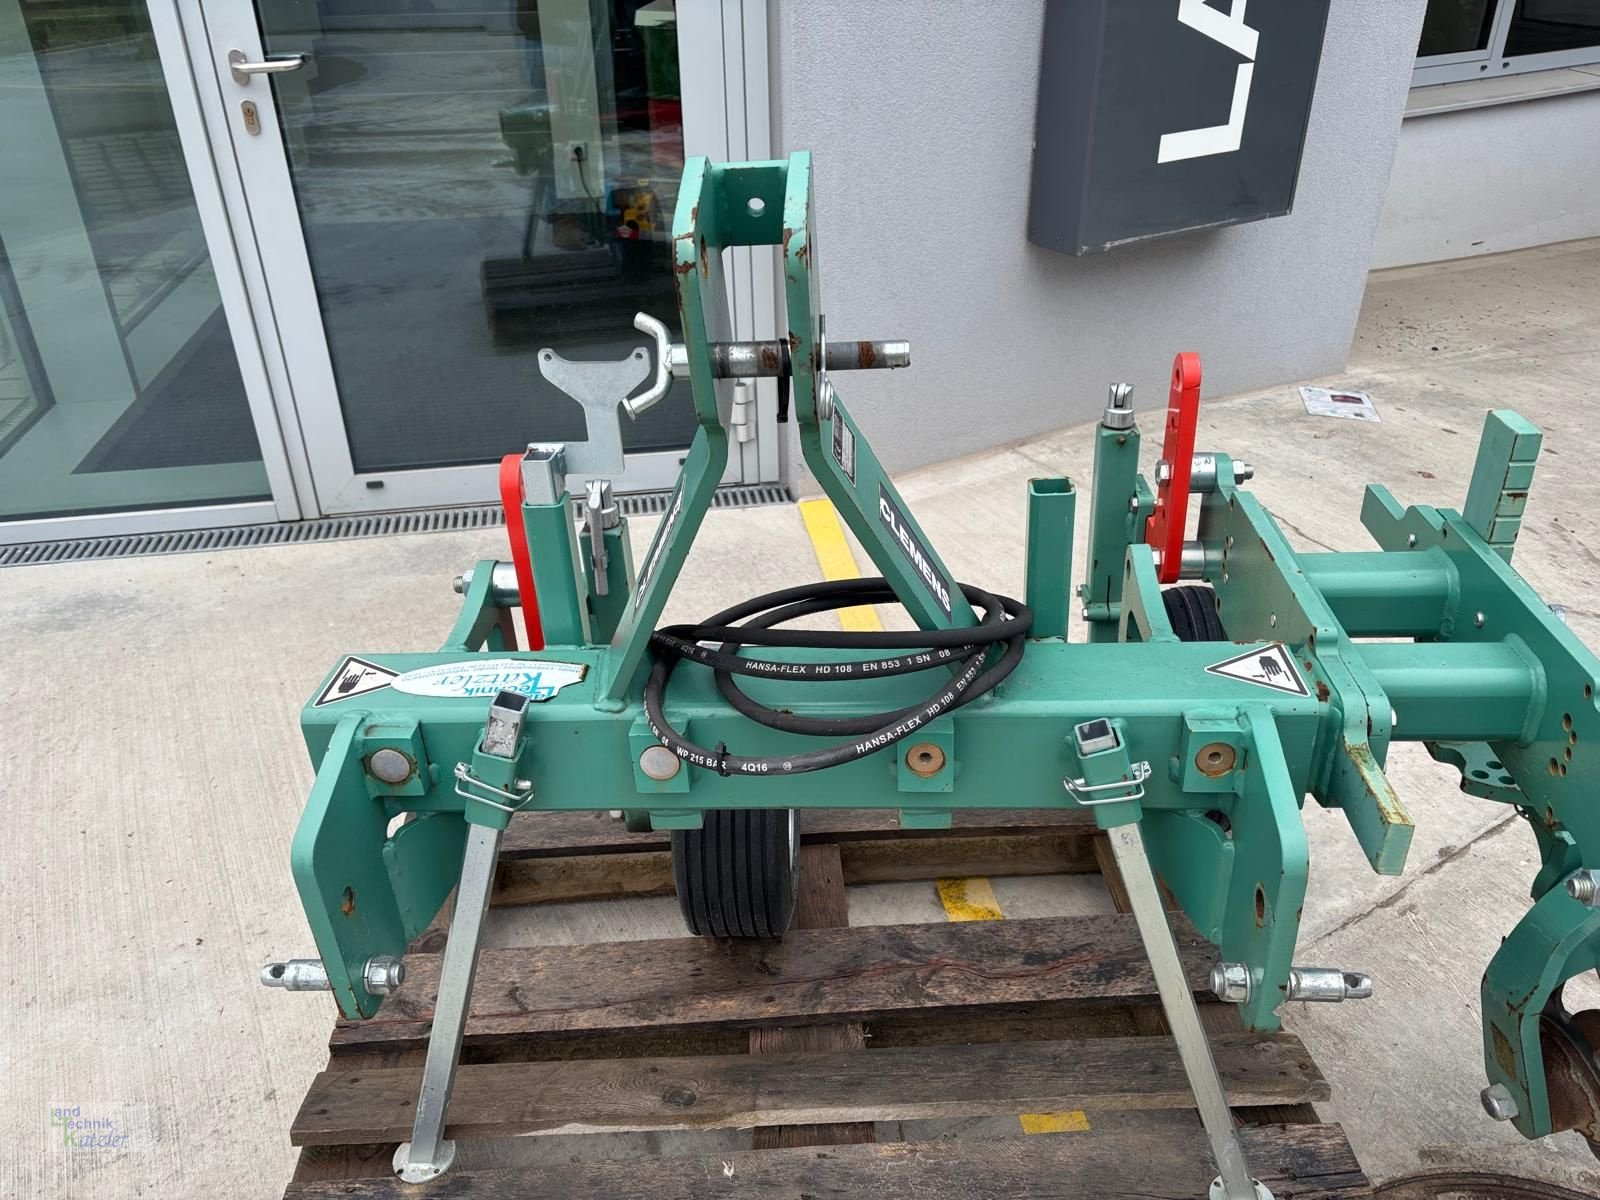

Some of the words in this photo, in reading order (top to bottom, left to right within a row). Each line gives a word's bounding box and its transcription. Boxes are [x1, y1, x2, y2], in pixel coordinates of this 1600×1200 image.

[880, 497, 951, 612] CLEMENS
[745, 661, 806, 674] HANSA-FLEX
[815, 666, 831, 674] HD
[835, 664, 852, 673] 108
[862, 663, 878, 672] EN
[881, 660, 901, 670] 853
[906, 657, 912, 665] 1
[916, 654, 931, 664] SN
[938, 649, 951, 658] 08
[855, 715, 922, 754] HANSA-FLEX
[926, 703, 941, 717] HD
[941, 692, 954, 706] 108
[956, 679, 968, 692] EN
[965, 667, 977, 681] 853
[676, 746, 689, 759] WP
[690, 753, 704, 765] 215
[741, 763, 768, 772] 4Q16
